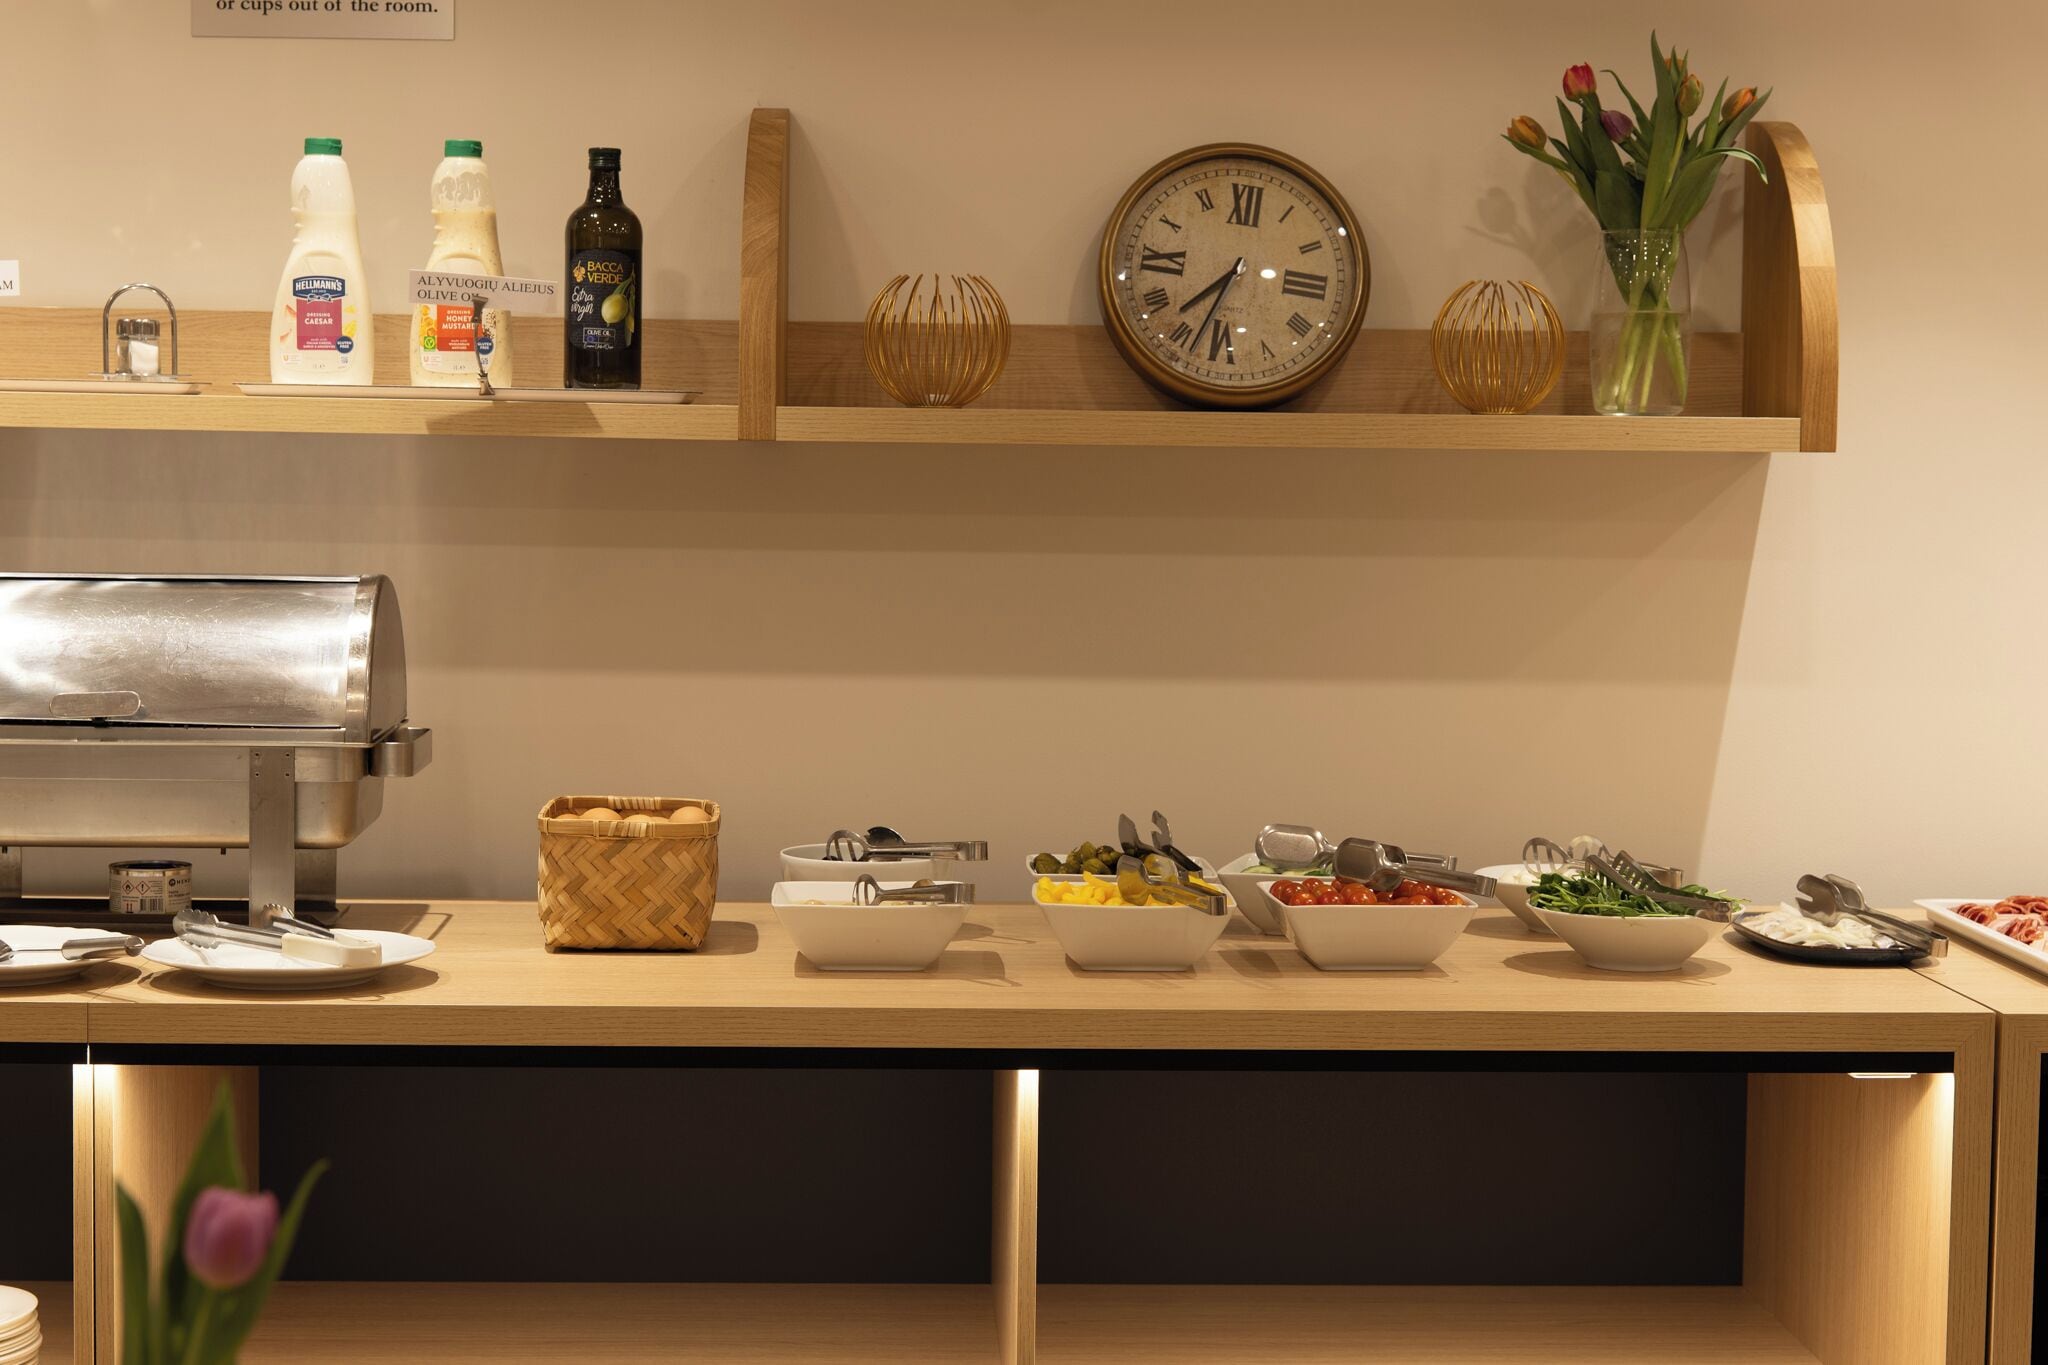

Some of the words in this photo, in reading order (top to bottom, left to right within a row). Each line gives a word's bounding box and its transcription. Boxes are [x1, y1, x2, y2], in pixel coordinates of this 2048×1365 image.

[216, 0, 235, 10] or
[240, 0, 283, 15] cups
[288, 0, 318, 11] out
[324, 0, 342, 12] of
[351, 0, 379, 12] the
[385, 1, 438, 13] room.
[1194, 188, 1215, 212] XI
[1226, 183, 1264, 228] XII
[1159, 214, 1182, 234] X
[587, 261, 624, 273] BACCA
[1140, 244, 1186, 277] IX
[295, 280, 342, 292] HELLMANN'S
[417, 275, 498, 292] ALYVUOGIŲ
[501, 281, 555, 295] ALIEJUS
[587, 272, 624, 285] VERDE
[1281, 269, 1328, 302] III
[417, 289, 458, 301] OLIVE
[304, 317, 333, 325] CAESAR
[570, 301, 594, 322] virgin
